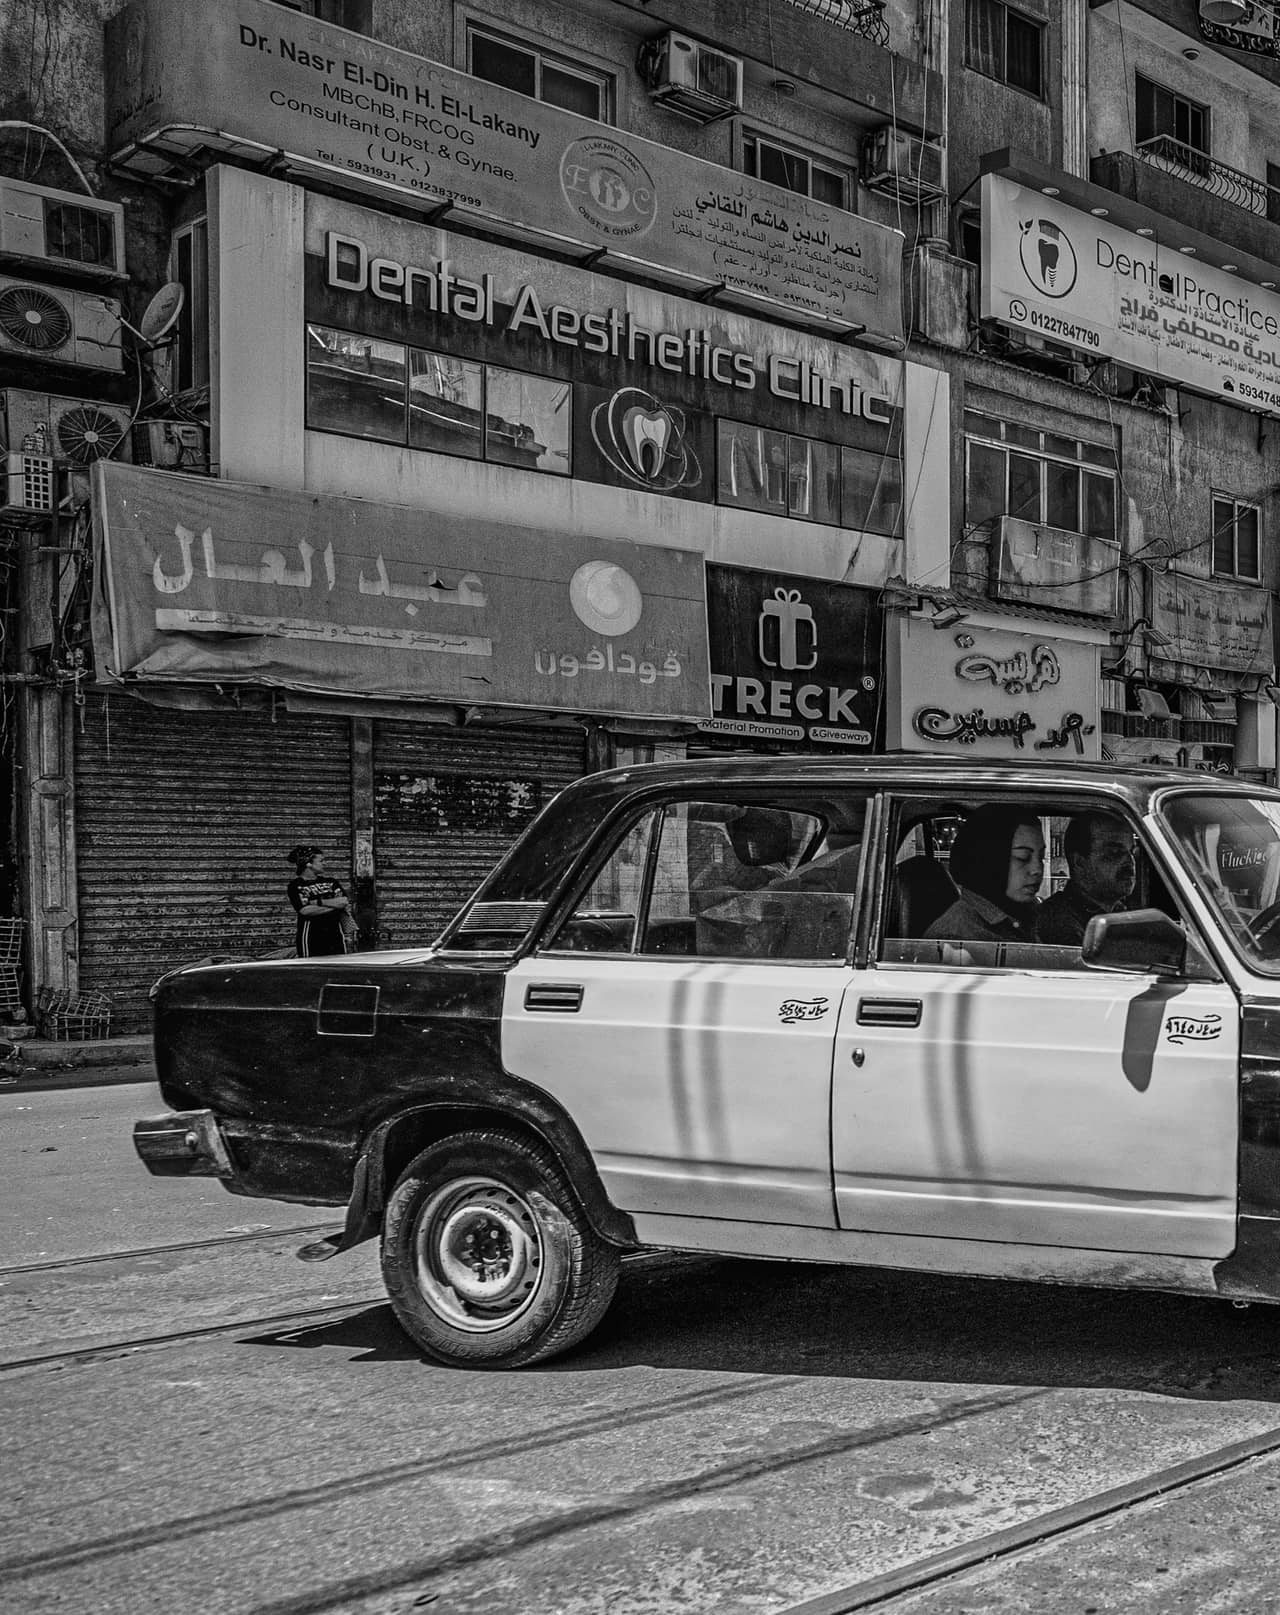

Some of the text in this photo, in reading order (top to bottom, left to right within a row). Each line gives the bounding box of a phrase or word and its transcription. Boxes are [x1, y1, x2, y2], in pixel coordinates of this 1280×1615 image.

[239, 23, 273, 54] Dr.
[278, 37, 336, 75] Nasr
[343, 60, 409, 102] El-Din
[415, 85, 436, 111] H.
[441, 97, 541, 150] El-Lakany
[269, 90, 519, 184] Consultant Obst. & Gynae.
[402, 109, 475, 147] FRCOG
[346, 158, 398, 182] 5931931
[409, 177, 483, 209] 0123837999
[694, 190, 749, 220] اللقاني
[750, 208, 791, 234] هاشم
[791, 221, 831, 247] الدين
[830, 242, 863, 260] نصر
[1119, 297, 1160, 323] فراج
[1184, 276, 1278, 337] Practice
[325, 229, 892, 424] Dental Aesthetics Clinic
[1031, 310, 1100, 348] 01227847790
[1162, 317, 1241, 353] مصطفى
[153, 524, 488, 617] عبد العال
[342, 626, 404, 641] خدمة
[409, 634, 470, 650] مركز
[711, 675, 860, 724] TRECK
[702, 720, 746, 734] Material
[748, 723, 800, 739] Promotion
